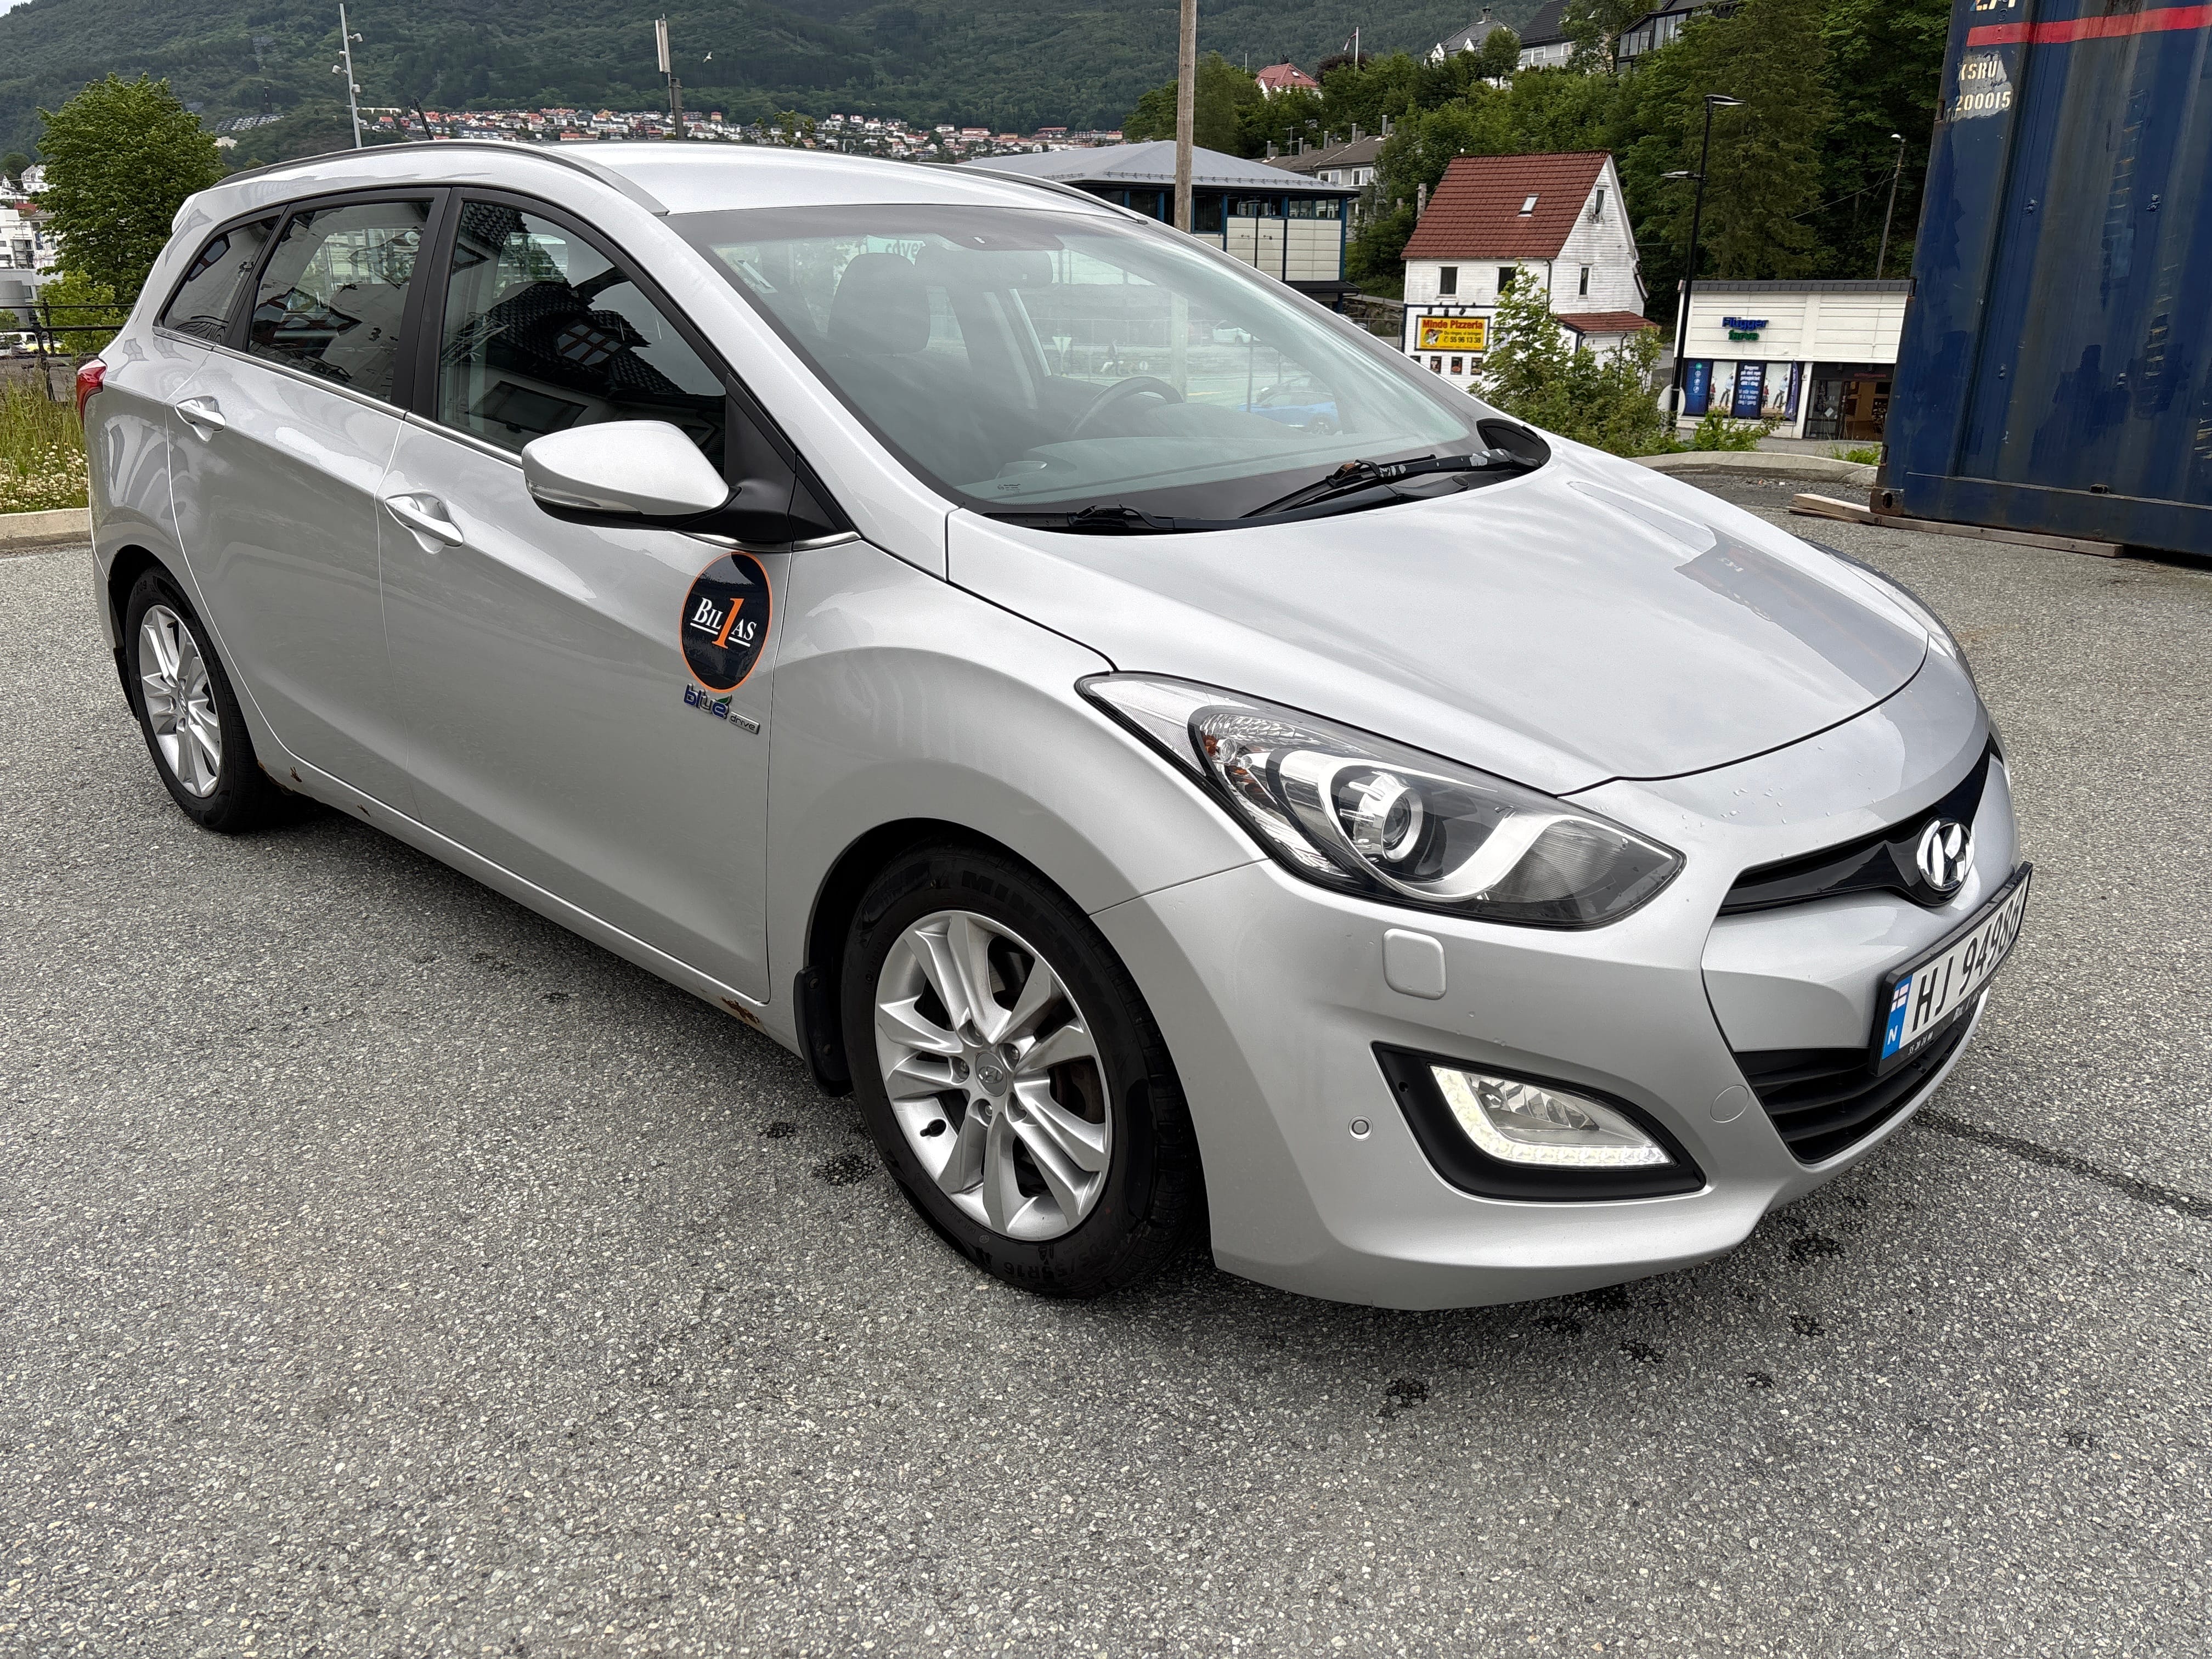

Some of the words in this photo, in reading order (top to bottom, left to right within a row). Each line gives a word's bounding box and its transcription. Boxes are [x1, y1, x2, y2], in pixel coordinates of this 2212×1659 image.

[1956, 92, 2011, 111] 200015
[1423, 320, 1448, 329] Minde
[1450, 320, 1483, 329] Pizzeria
[1728, 330, 1760, 340] farve
[684, 683, 731, 720] blue
[730, 714, 756, 731] drive
[1911, 955, 1954, 1034] HJ
[1959, 883, 2024, 997] 94986
[1887, 1025, 1898, 1045] N
